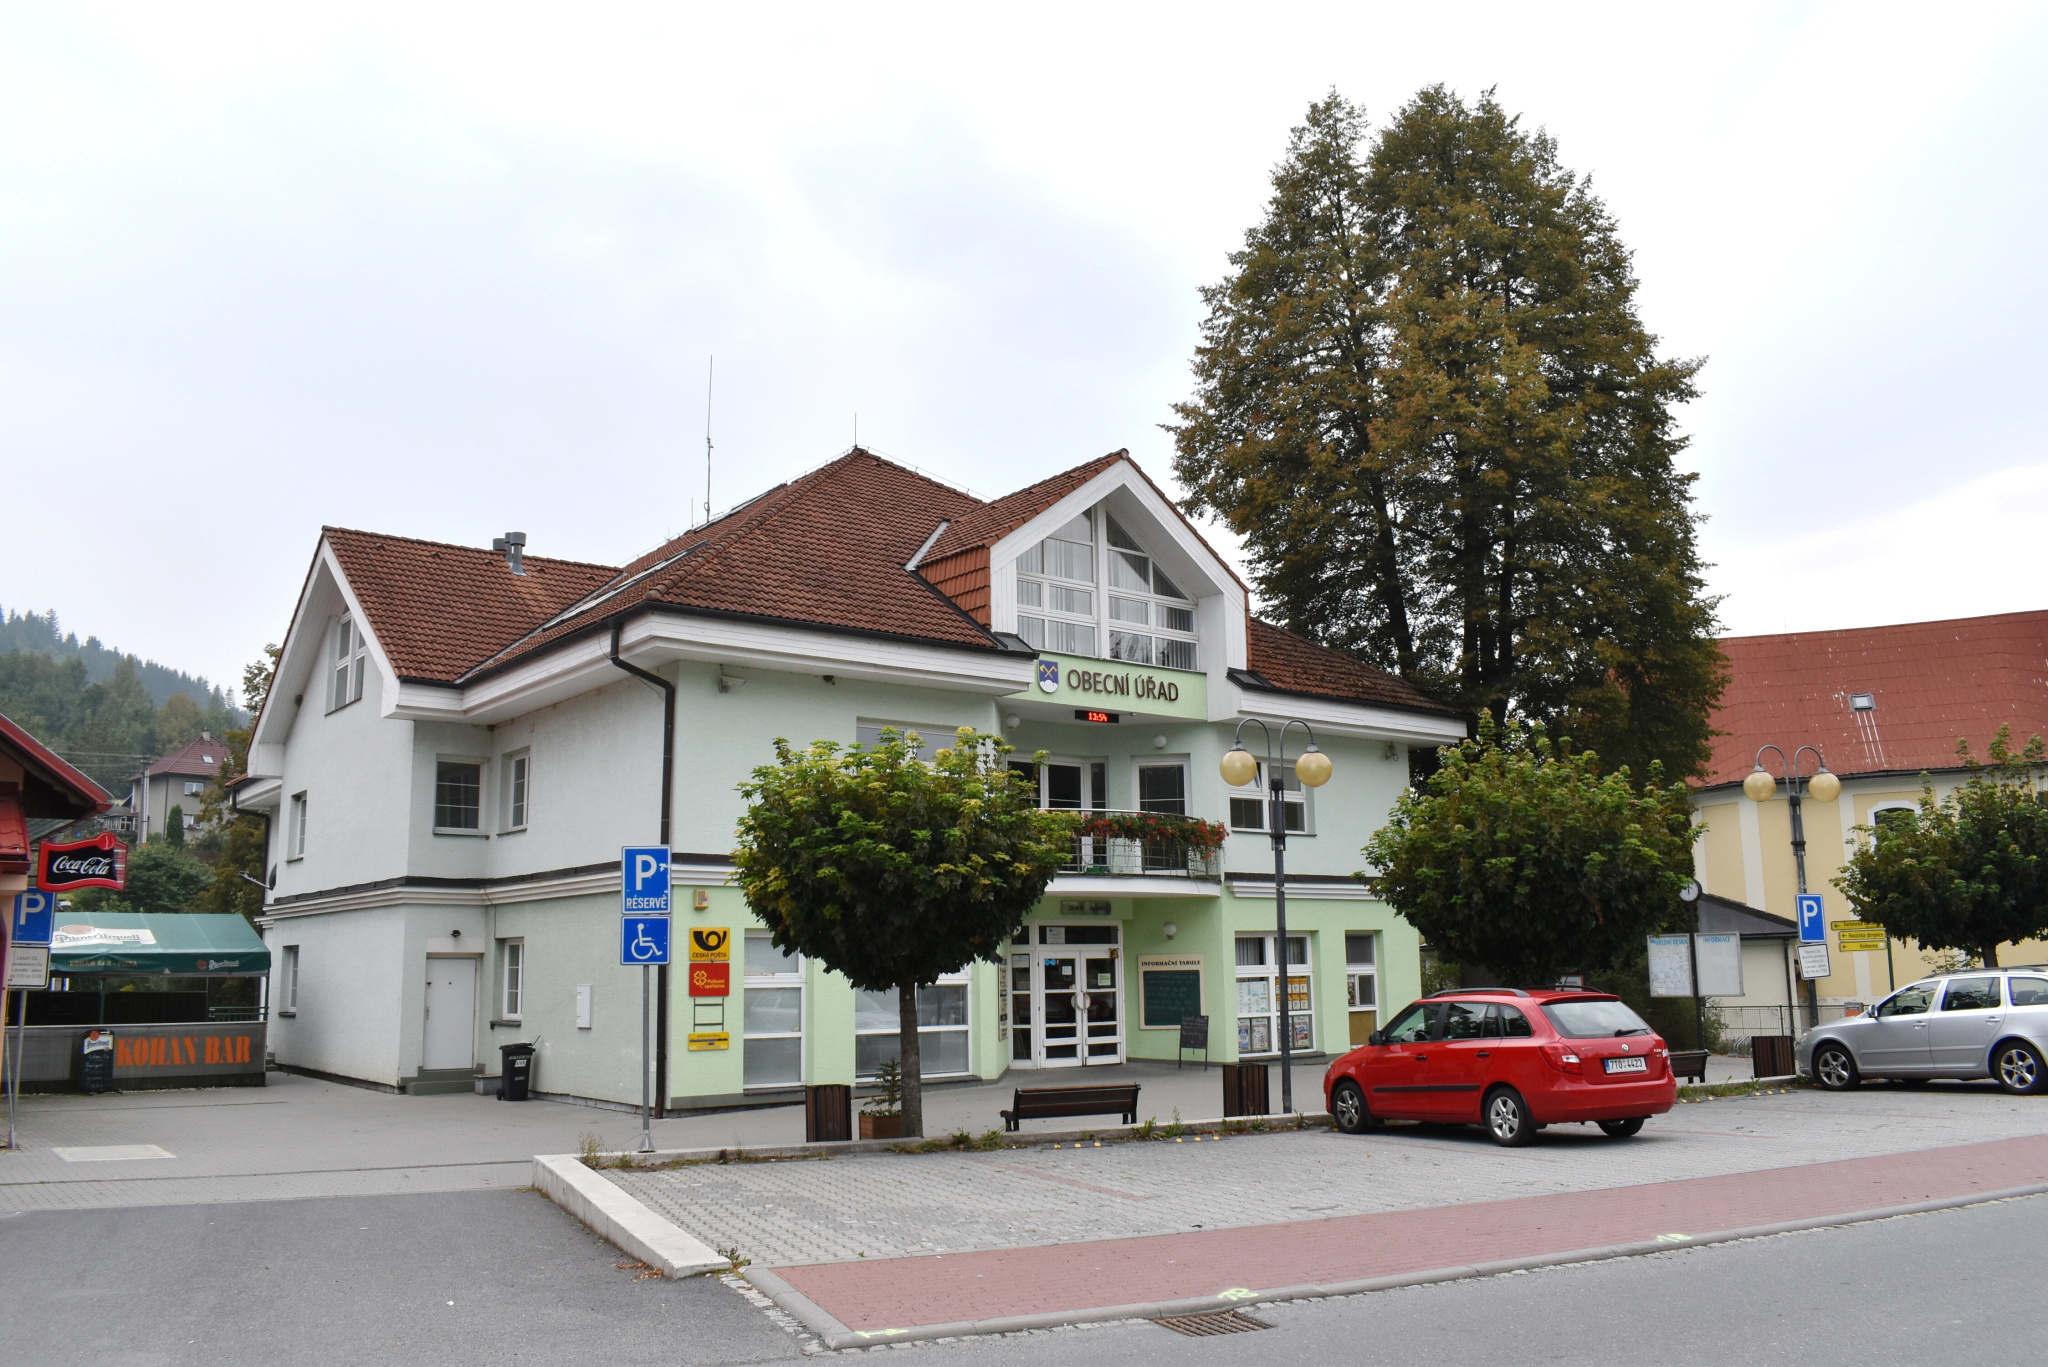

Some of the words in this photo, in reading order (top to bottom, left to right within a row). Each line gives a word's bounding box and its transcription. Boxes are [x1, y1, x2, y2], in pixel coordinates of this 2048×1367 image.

[1067, 669, 1130, 696] OBECNÍ
[1134, 674, 1179, 702] ÚŘAD
[1088, 711, 1108, 722] 13:54
[52, 855, 113, 875] Coca-Cola
[635, 854, 657, 890] P
[19, 892, 46, 925] P
[626, 894, 667, 909] RÉSERVÉ
[1802, 900, 1818, 927] P
[115, 1036, 198, 1067] KOHAN
[204, 1036, 251, 1064] BAR
[1627, 1058, 1643, 1068] 4423
